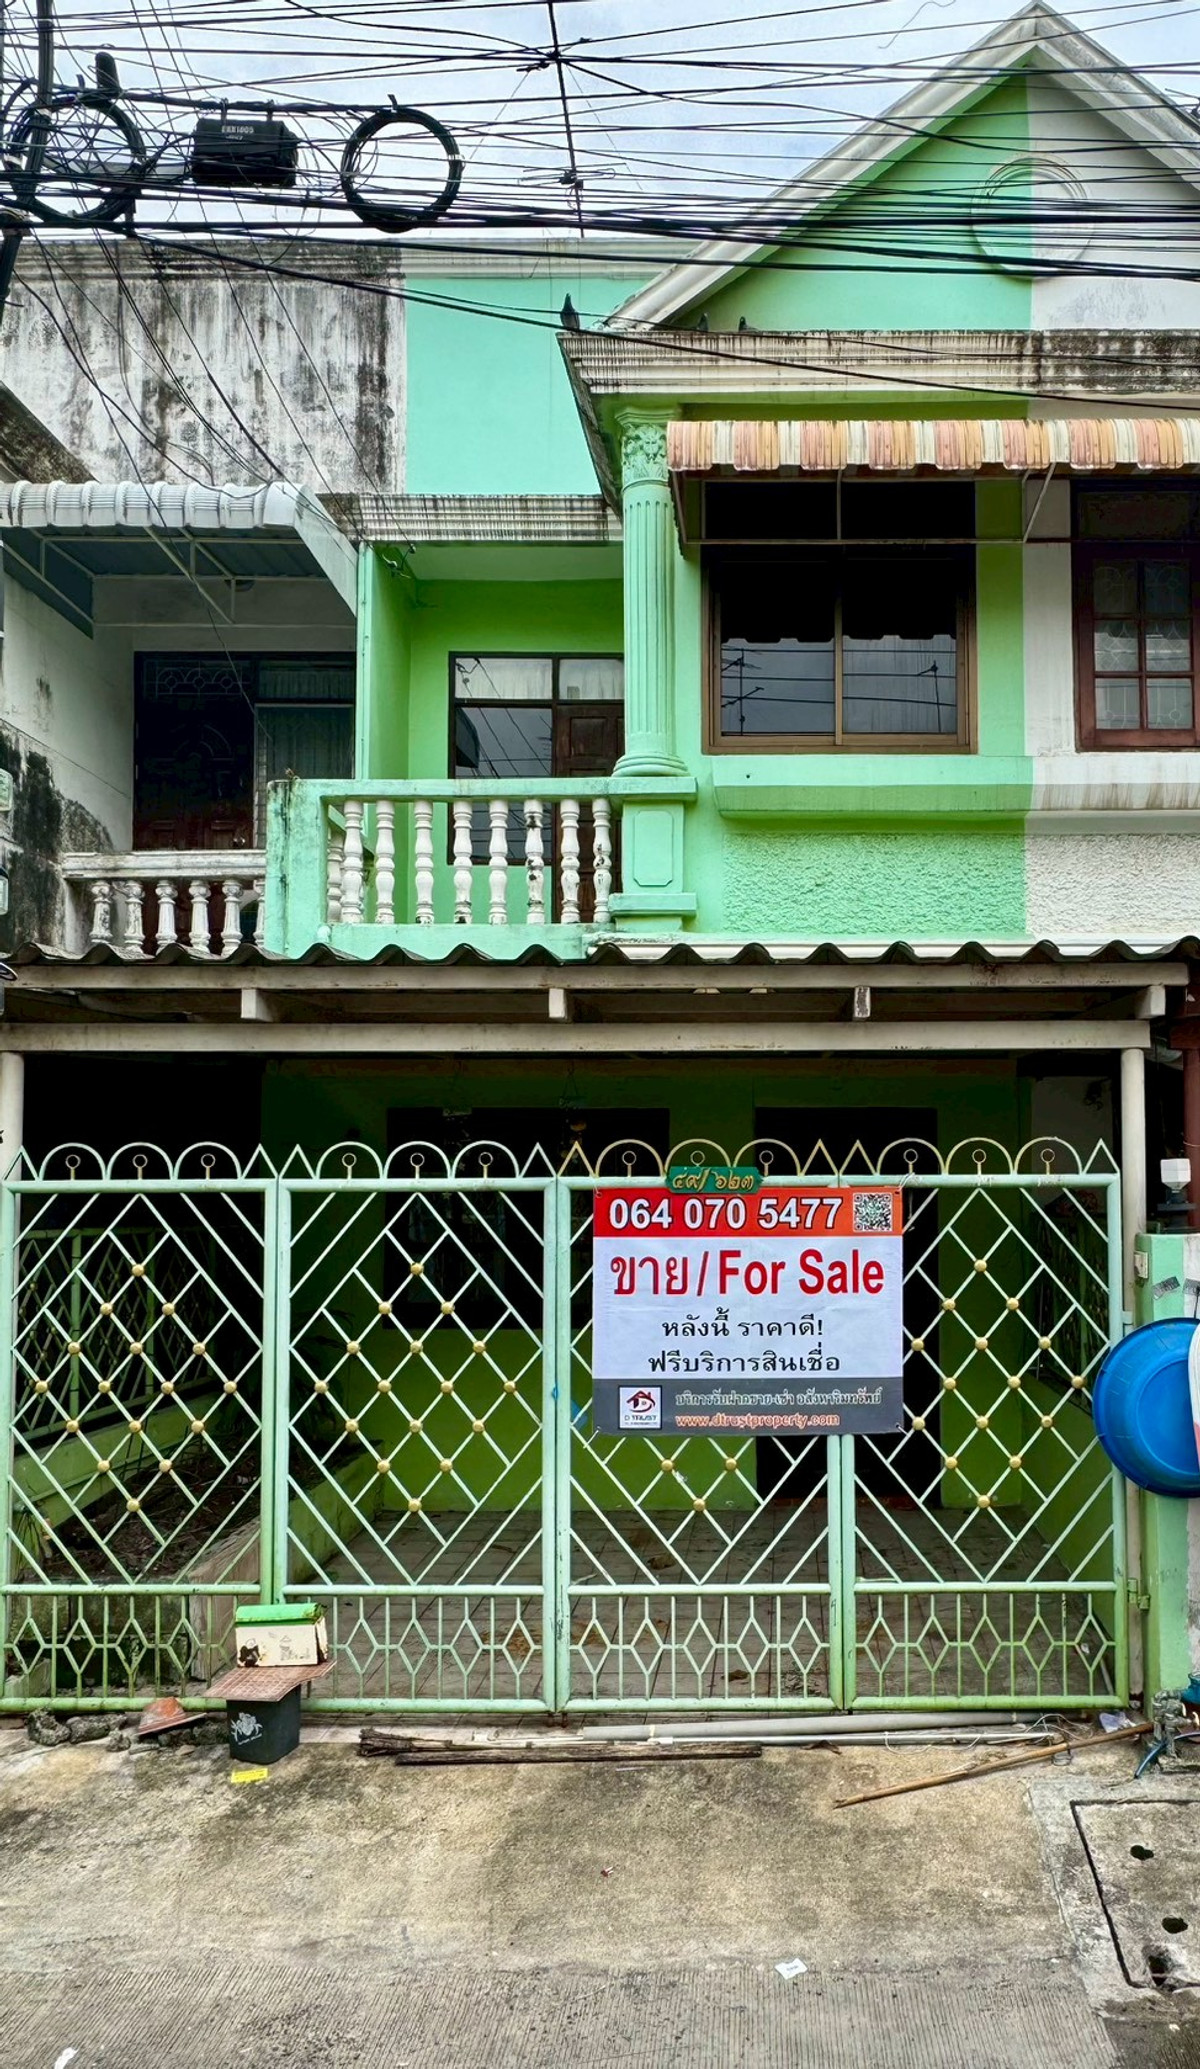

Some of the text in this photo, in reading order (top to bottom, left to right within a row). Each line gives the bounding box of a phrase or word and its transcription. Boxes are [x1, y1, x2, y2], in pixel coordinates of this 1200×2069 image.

[609, 1197, 843, 1230] 064 070 5477
[799, 1248, 885, 1296] Sale
[661, 1306, 824, 1337] หลังนี้ ราคาดี!
[648, 1341, 841, 1373] ฟรีบริการสินเชื่อ
[674, 1411, 841, 1430] www.dtrustproperty.com
